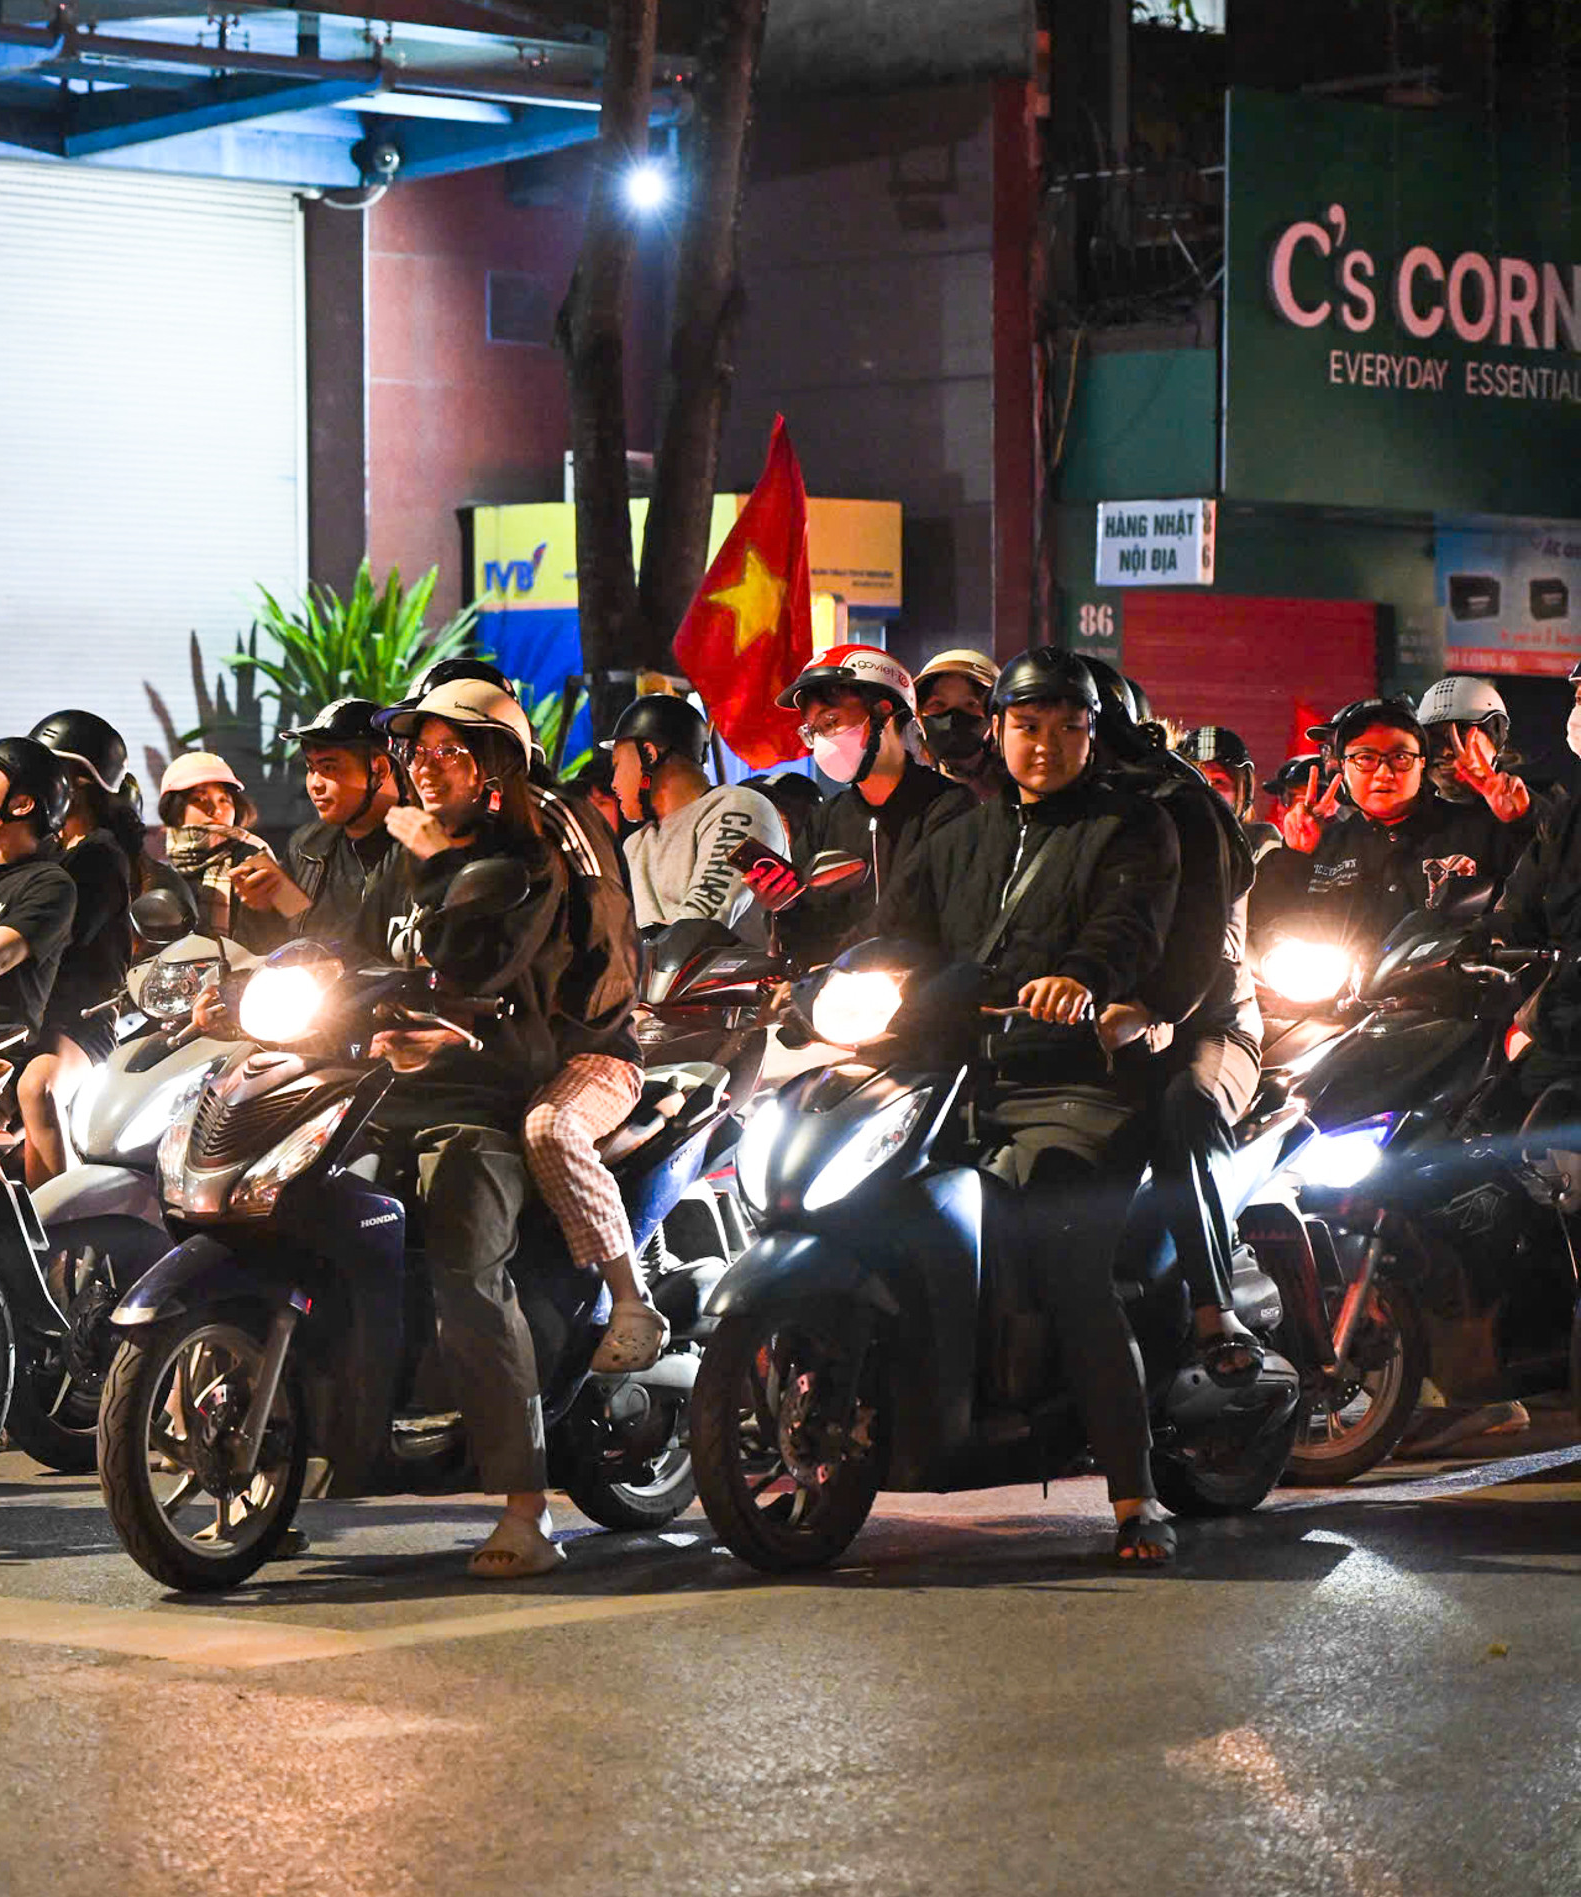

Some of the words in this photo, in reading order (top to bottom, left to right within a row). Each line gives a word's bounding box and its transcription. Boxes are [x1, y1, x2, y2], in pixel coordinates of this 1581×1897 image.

[1273, 203, 1376, 332] C's
[1399, 246, 1581, 349] CORN
[1330, 350, 1448, 390] EVERYDAY
[1105, 511, 1148, 538] HÀNG
[1154, 509, 1195, 540] NHẬT
[1119, 544, 1146, 577] NỘI
[1150, 548, 1177, 575] ĐỊA
[1079, 603, 1114, 637] 86
[360, 1212, 399, 1228] HONDA
